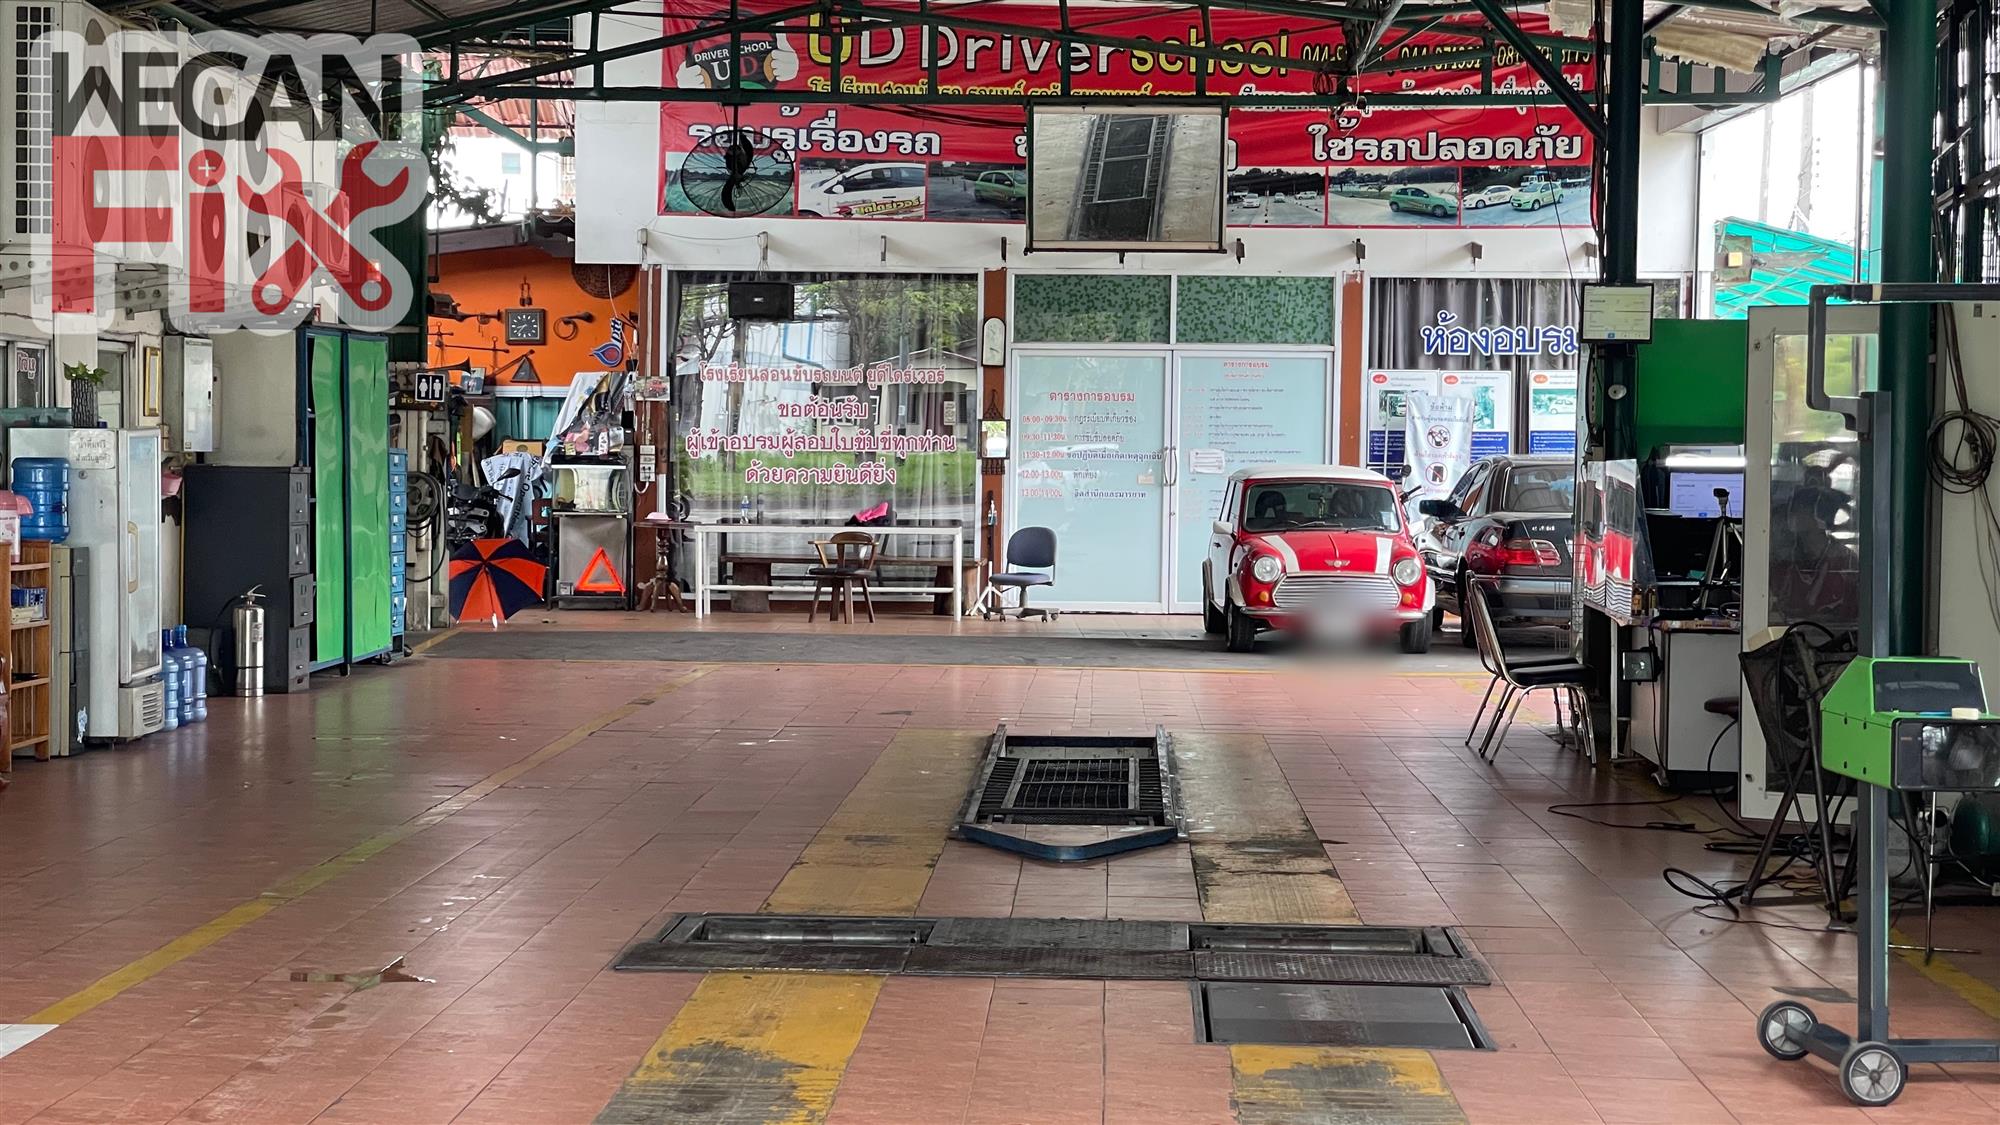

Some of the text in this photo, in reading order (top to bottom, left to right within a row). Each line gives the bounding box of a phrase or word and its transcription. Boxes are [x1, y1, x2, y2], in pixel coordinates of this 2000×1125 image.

[694, 49, 729, 62] DRIVER
[1307, 117, 1583, 162] ใช้รถปลอดภัย
[699, 361, 864, 384] โรงเรียนสอนขับรถยนต์
[777, 395, 868, 419] ขอต้อนรับ
[686, 424, 956, 458] ผู้เข้าอบรมผู้สอบใบขับขี่ทุกท่าน
[745, 457, 897, 485] ด้วยความยินดียิ่ง
